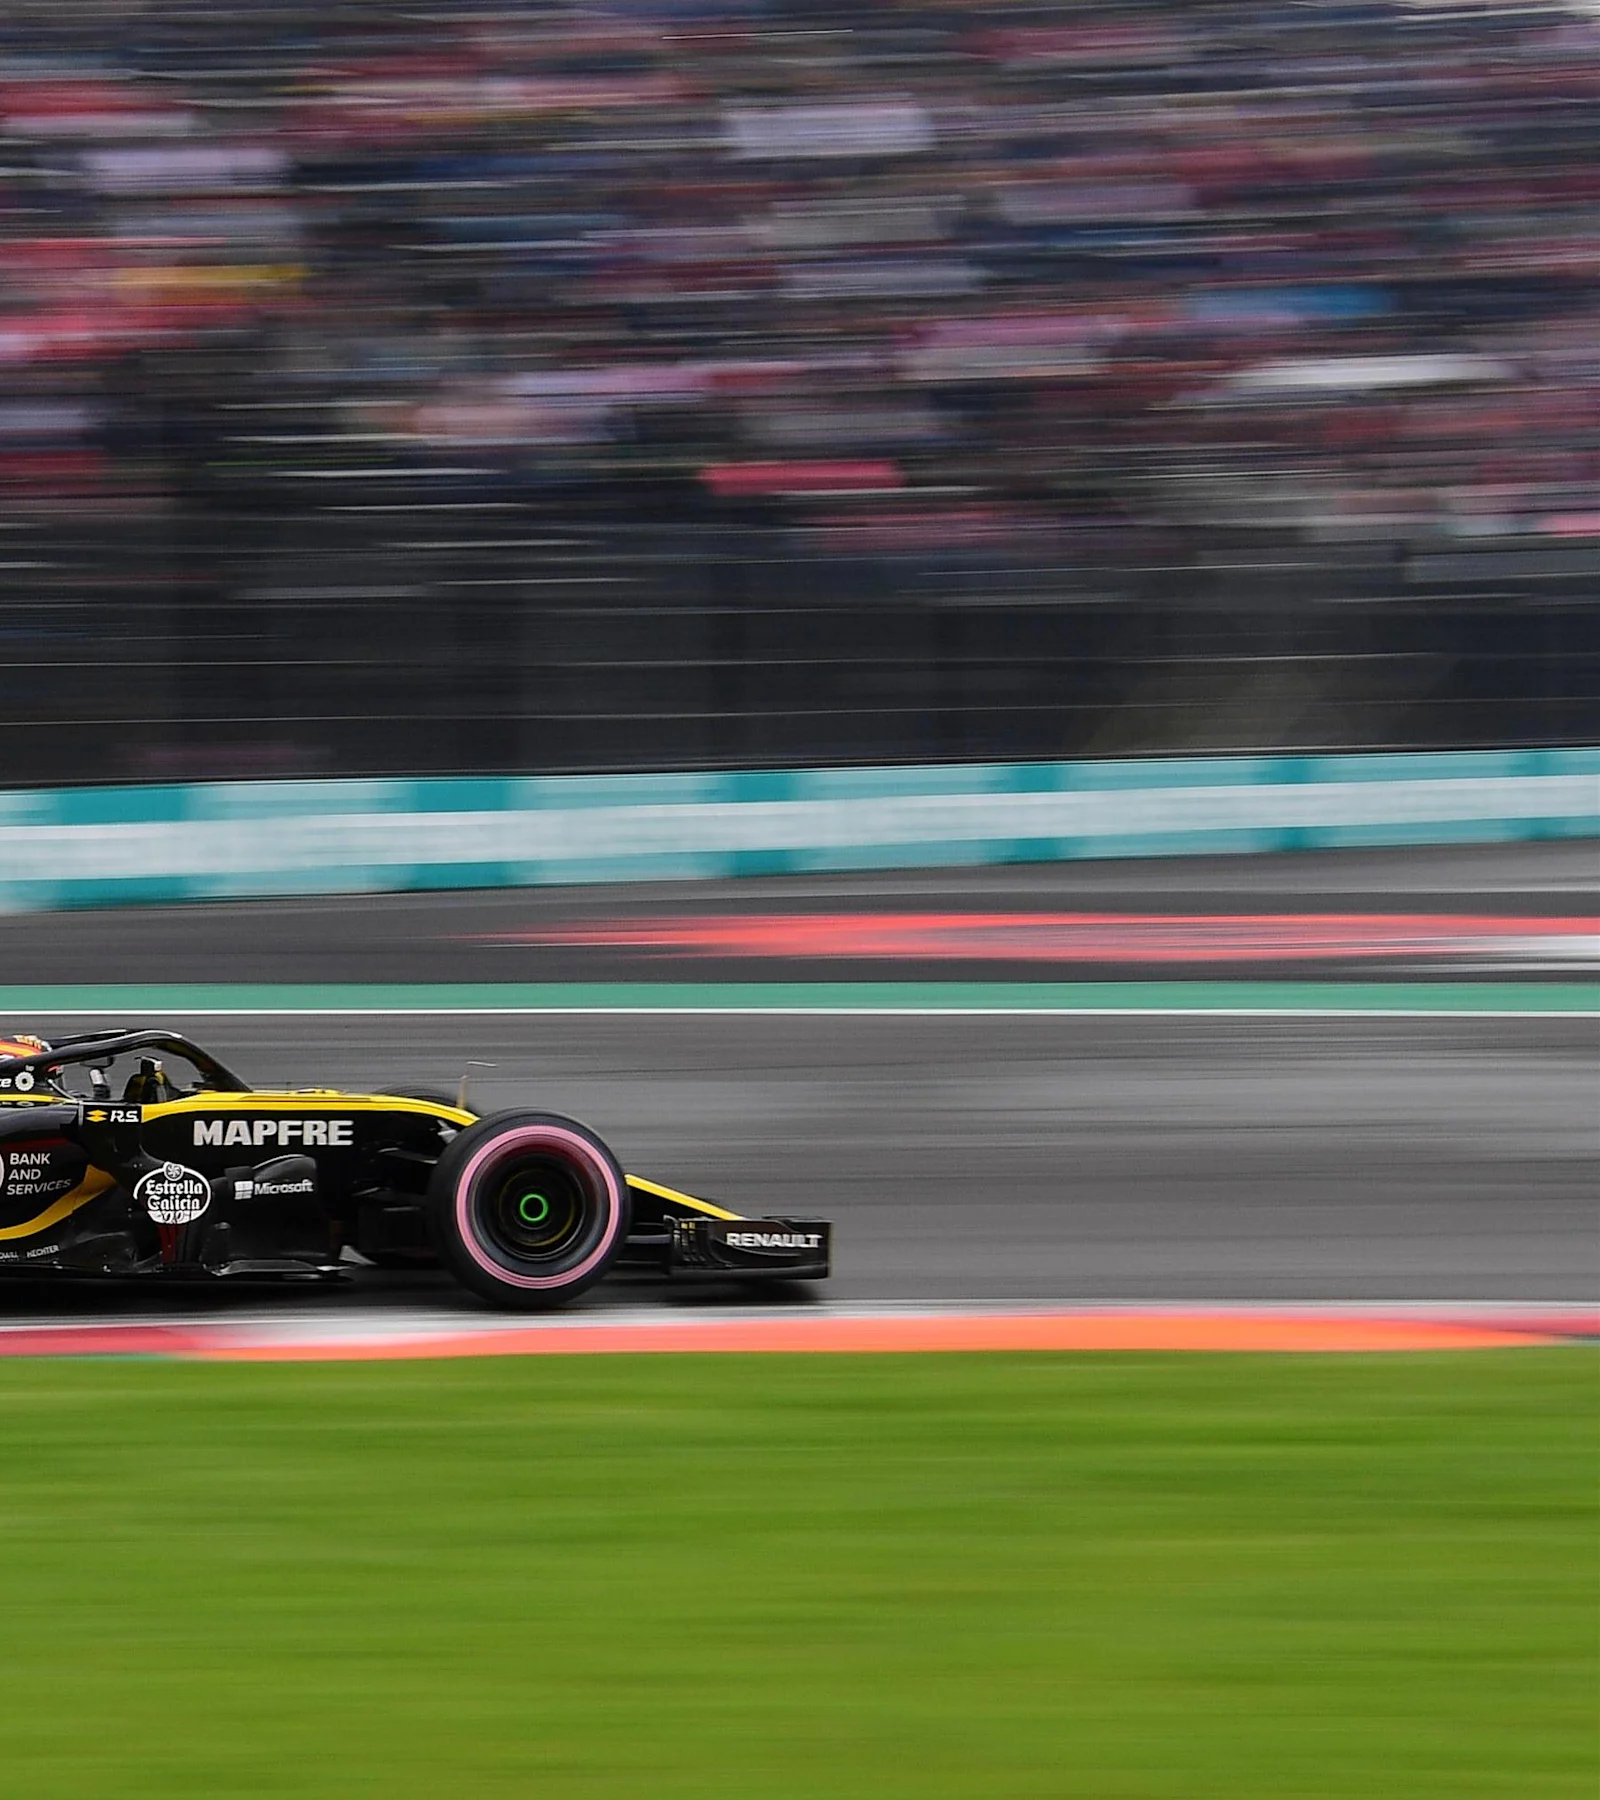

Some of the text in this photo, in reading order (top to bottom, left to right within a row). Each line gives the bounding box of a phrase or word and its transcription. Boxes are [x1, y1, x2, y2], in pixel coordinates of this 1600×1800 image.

[193, 1120, 354, 1146] MAPFRE
[9, 1152, 51, 1165] BANK
[8, 1168, 42, 1181] AND
[6, 1178, 72, 1196] SERVICES
[145, 1179, 204, 1195] Estrella
[254, 1178, 314, 1195] Microsoft
[726, 1232, 823, 1248] RENAULT
